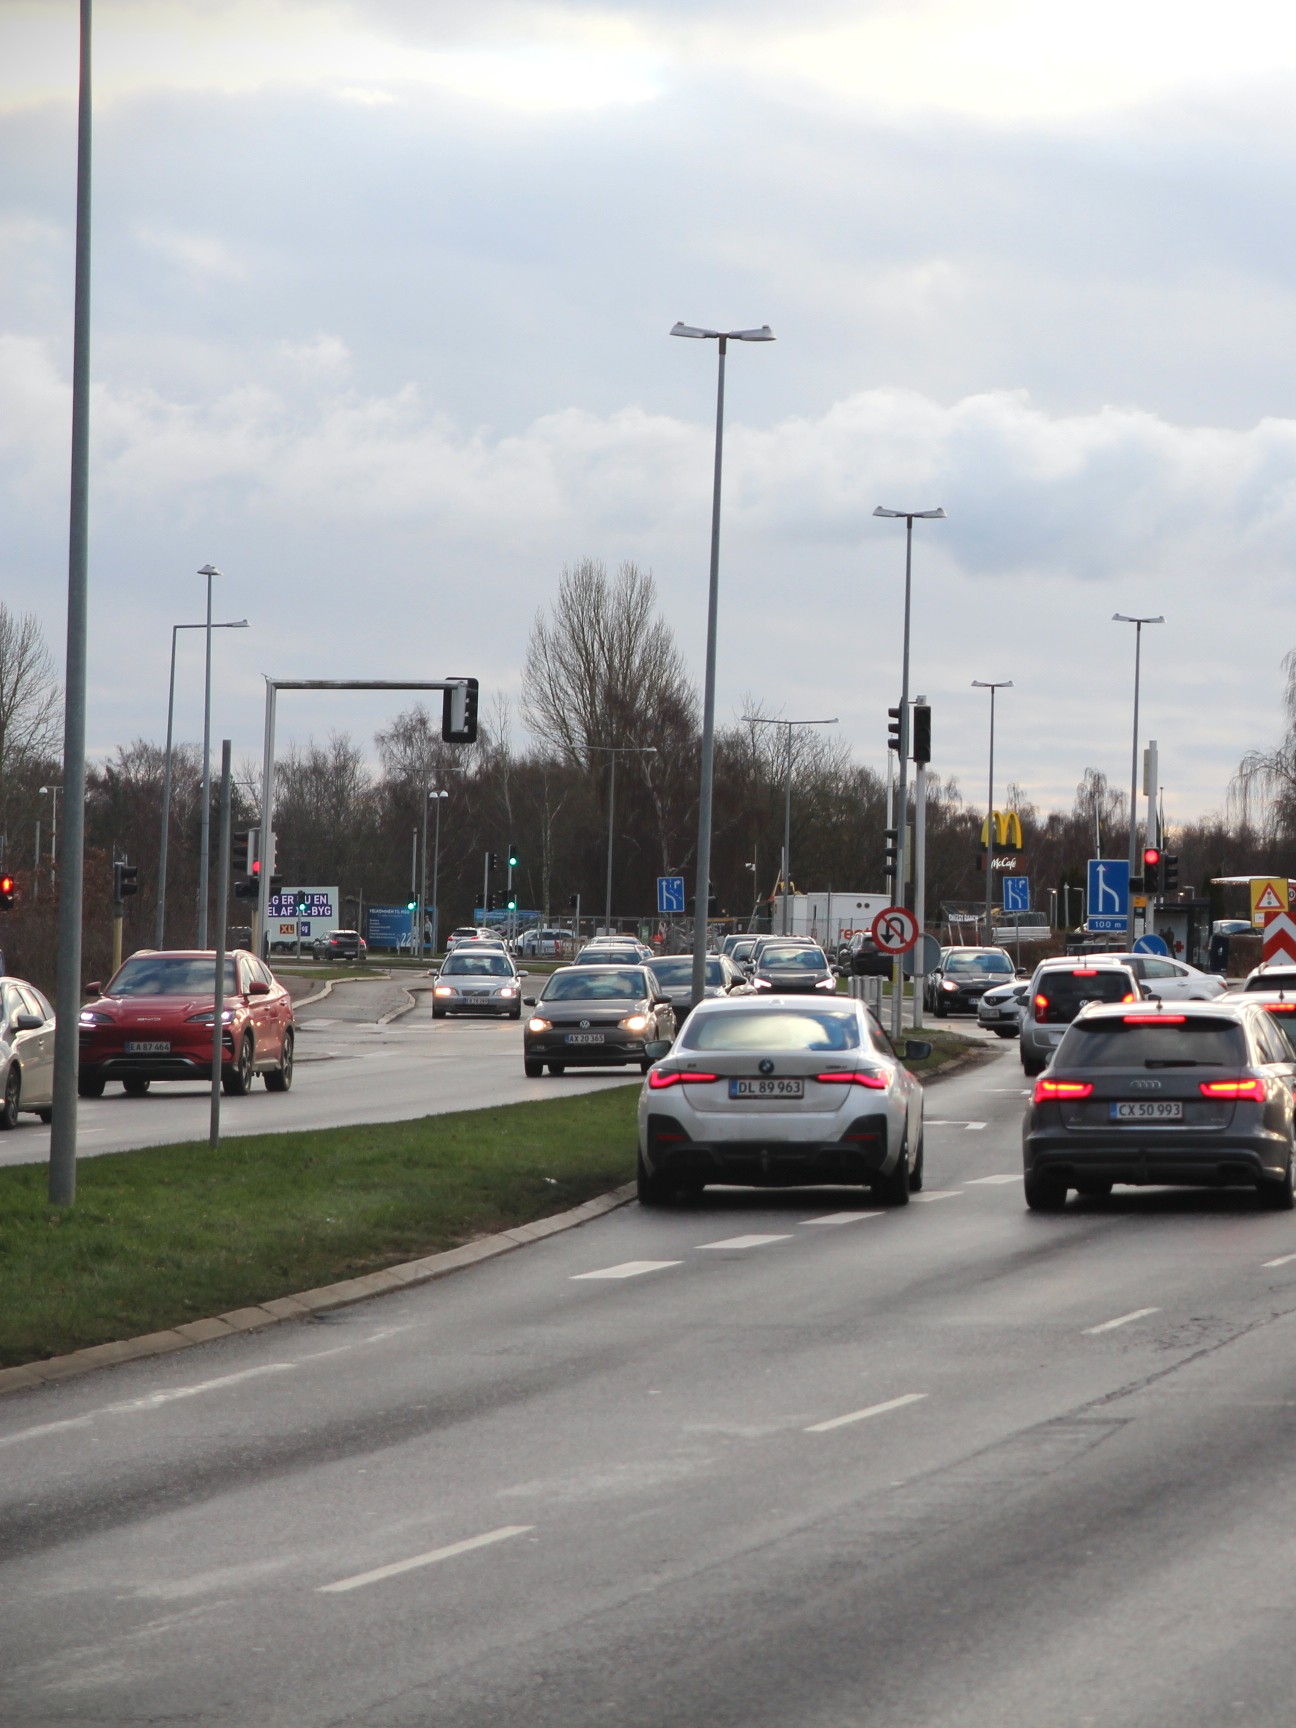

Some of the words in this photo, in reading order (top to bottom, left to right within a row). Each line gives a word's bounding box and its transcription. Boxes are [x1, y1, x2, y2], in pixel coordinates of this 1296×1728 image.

[281, 895, 294, 905] ER
[314, 895, 327, 904] EN
[280, 907, 293, 916] AF
[281, 925, 294, 933] XL
[130, 1043, 141, 1051] EA
[143, 1043, 153, 1051] 87
[738, 1082, 755, 1093] DL
[759, 1082, 775, 1093] 89
[779, 1082, 801, 1093] 963
[1118, 1104, 1136, 1116] CX
[1139, 1104, 1154, 1116] 50
[1159, 1104, 1181, 1116] 993
